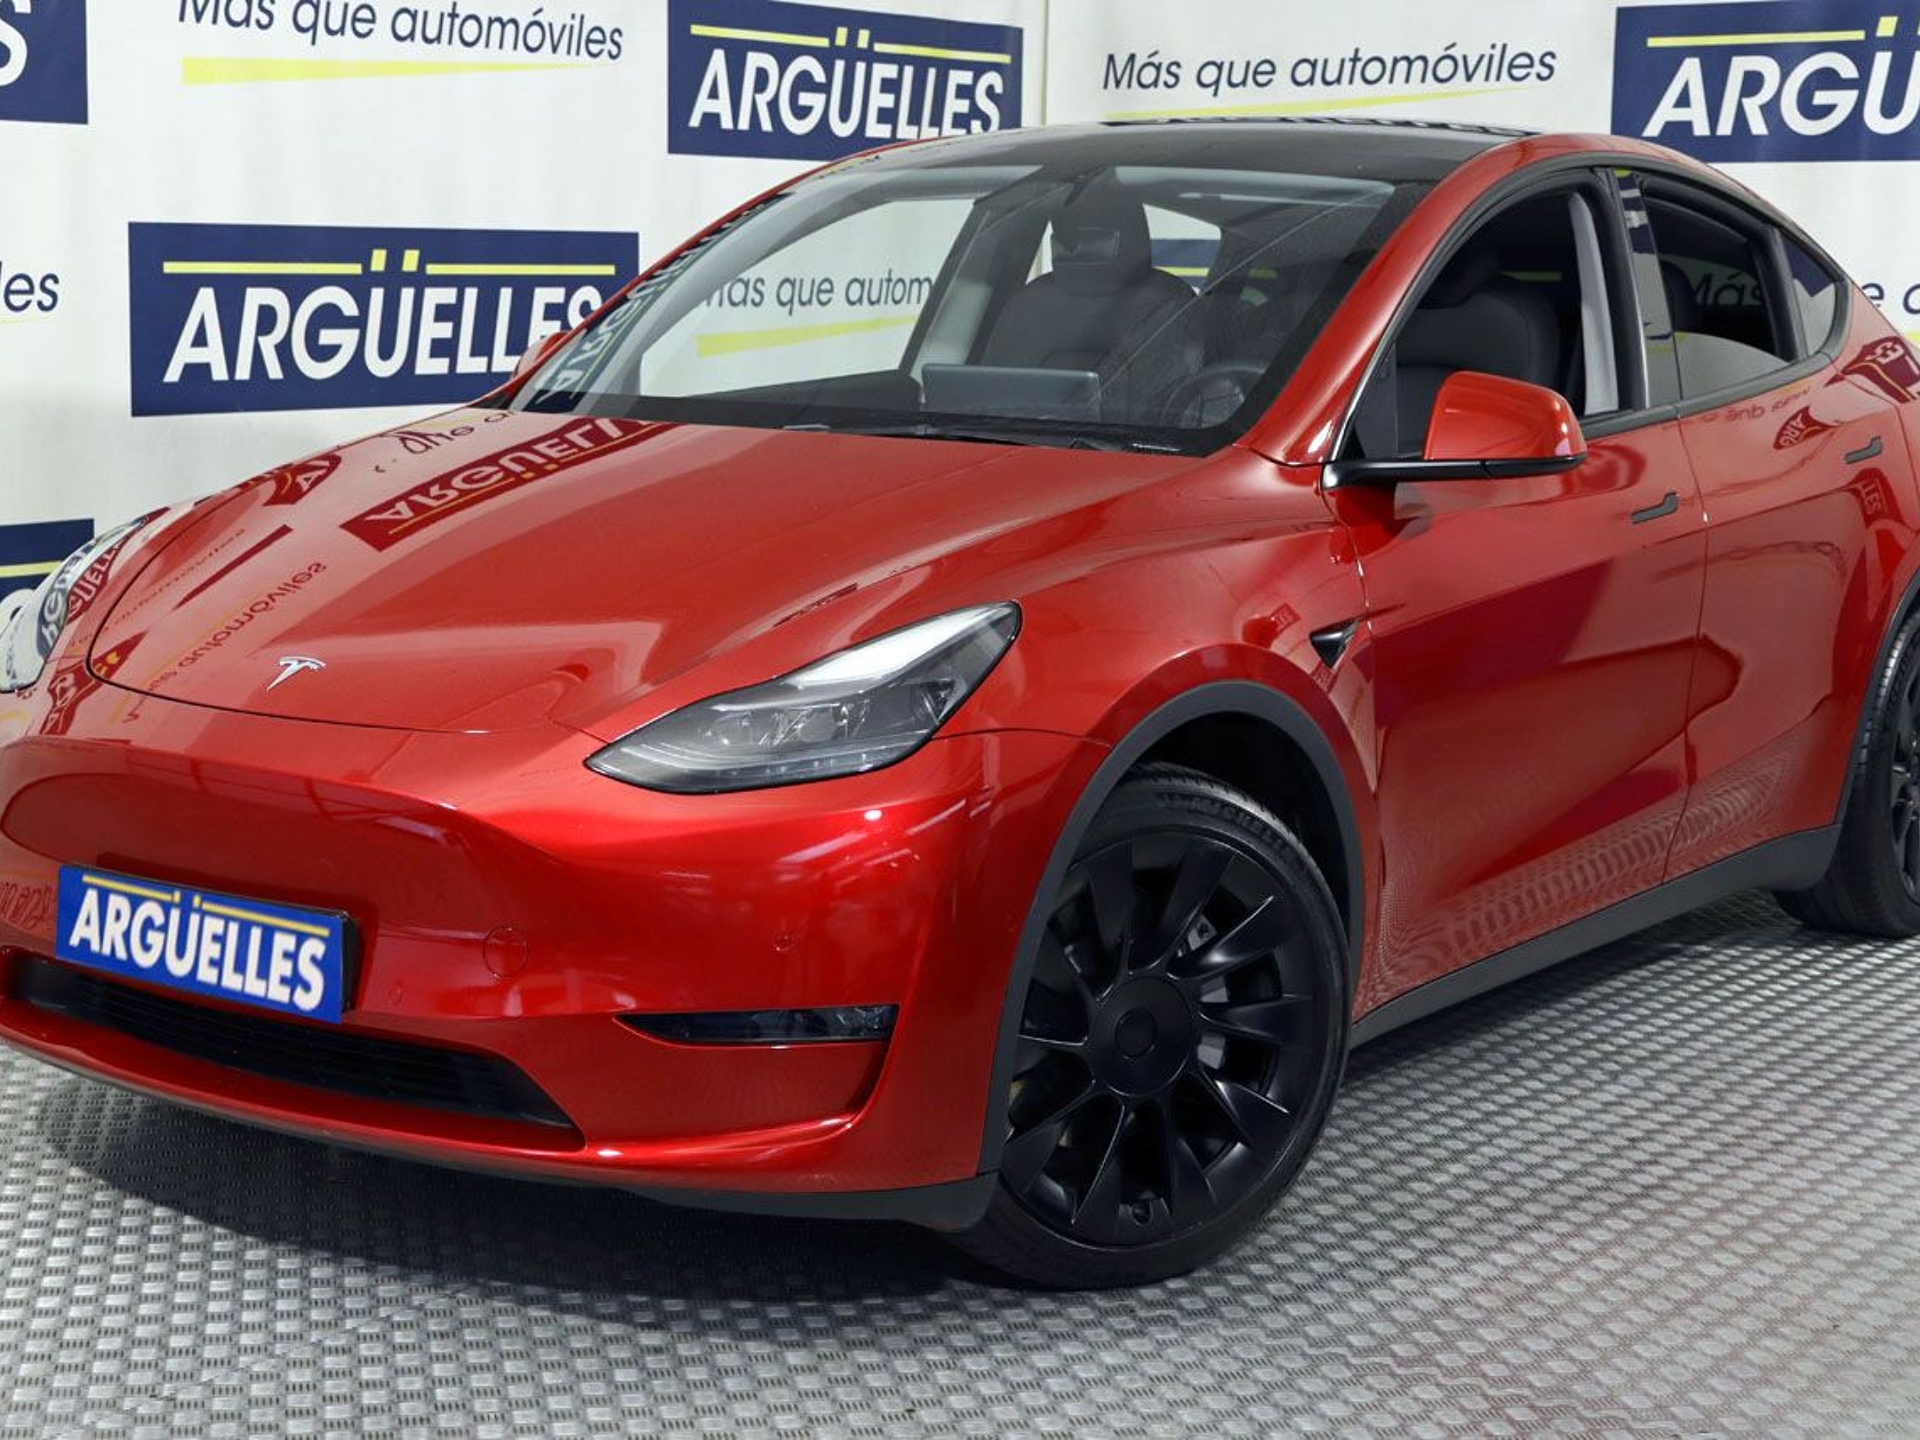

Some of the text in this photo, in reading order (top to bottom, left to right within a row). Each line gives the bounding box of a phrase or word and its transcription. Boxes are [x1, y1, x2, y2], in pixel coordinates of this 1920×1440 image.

[293, 0, 376, 46] que
[391, 2, 623, 60] automóviles
[688, 27, 1004, 139] ARGÜELLES
[1103, 42, 1556, 97] Más que automóviles
[776, 276, 834, 316] que
[69, 888, 326, 1011] ARGÜELLES
